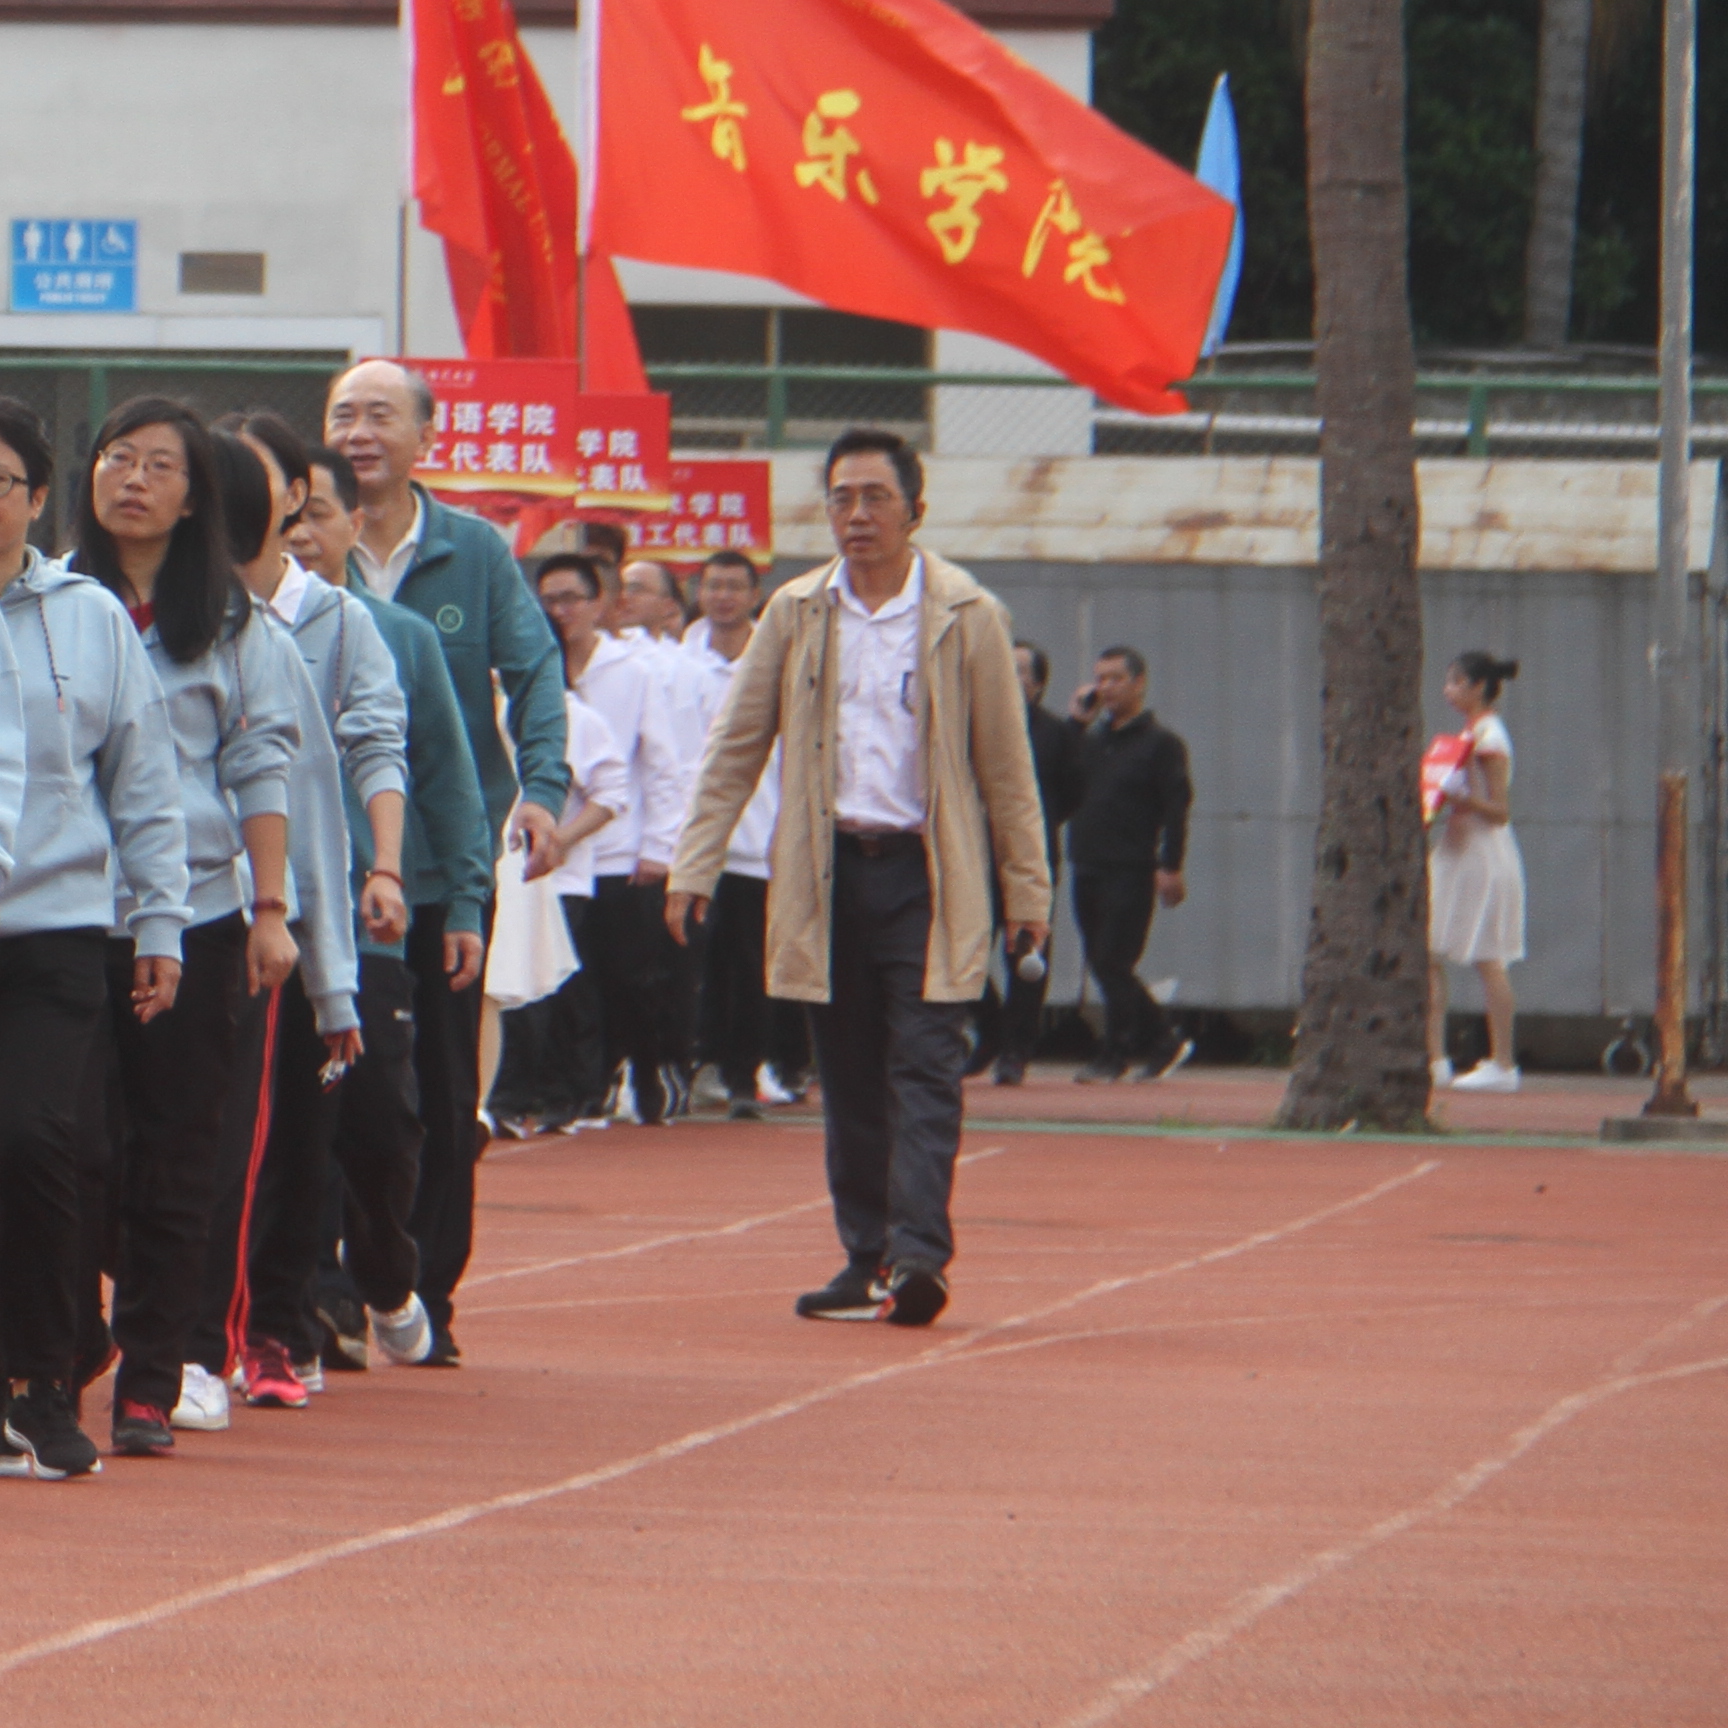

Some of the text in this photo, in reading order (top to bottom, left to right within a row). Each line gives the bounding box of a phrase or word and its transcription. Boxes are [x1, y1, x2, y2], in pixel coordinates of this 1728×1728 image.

[680, 40, 1128, 306] 音乐学院
[576, 428, 640, 459] 学院
[575, 463, 649, 492] 表队
